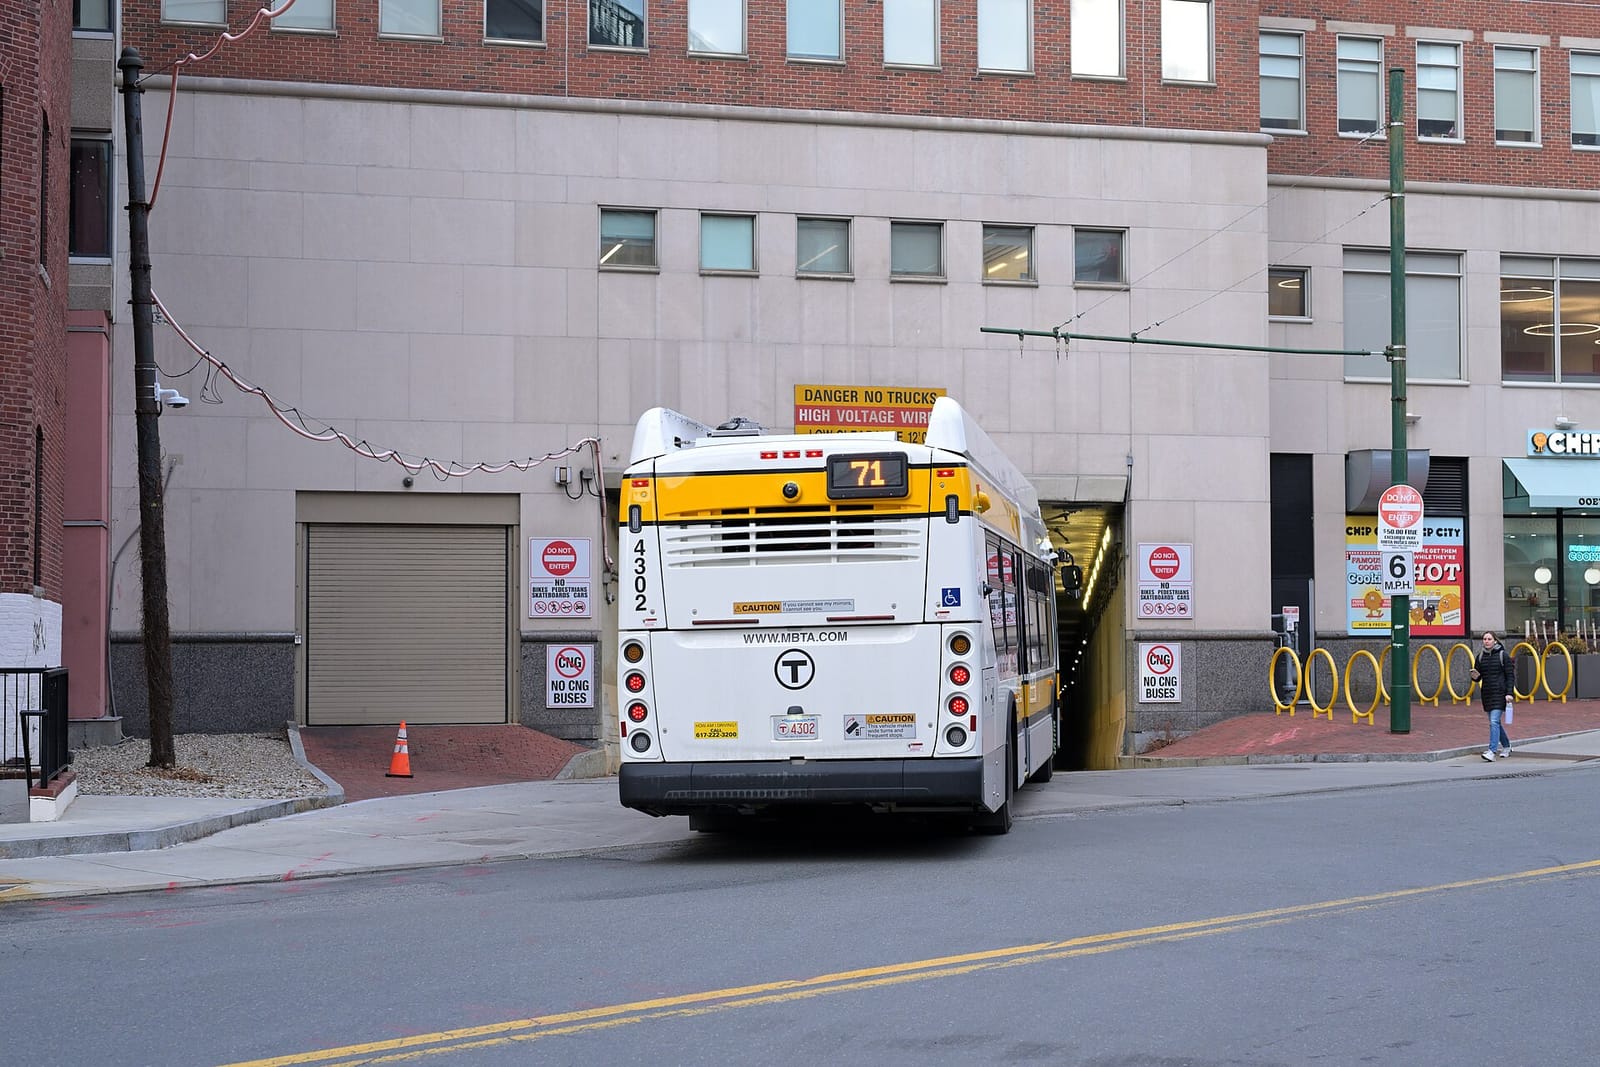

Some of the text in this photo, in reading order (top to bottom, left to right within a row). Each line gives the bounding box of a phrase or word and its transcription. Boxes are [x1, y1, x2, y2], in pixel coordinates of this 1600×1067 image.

[804, 389, 937, 405] DANGER NO TRUCKS
[799, 408, 830, 422] HIGH
[836, 409, 895, 423] VOLTAGE
[850, 460, 885, 486] 71
[1386, 494, 1417, 502] DO NOT
[1578, 497, 1600, 506] OOE
[1389, 555, 1406, 579] 6
[1414, 563, 1461, 581] HOT
[633, 539, 647, 611] 4302
[1384, 581, 1412, 590] M.P.H.
[741, 603, 780, 612] CAUTION
[743, 631, 848, 644] WWW.MBTA.COM
[558, 656, 582, 668] CNG
[1150, 654, 1170, 665] CNG
[551, 680, 589, 691] NO CNG
[1143, 676, 1177, 687] NO CNG
[553, 692, 587, 704] BUSES
[1145, 688, 1176, 699] BUSES
[875, 715, 914, 723] CAUTION
[791, 722, 815, 735] 4302
